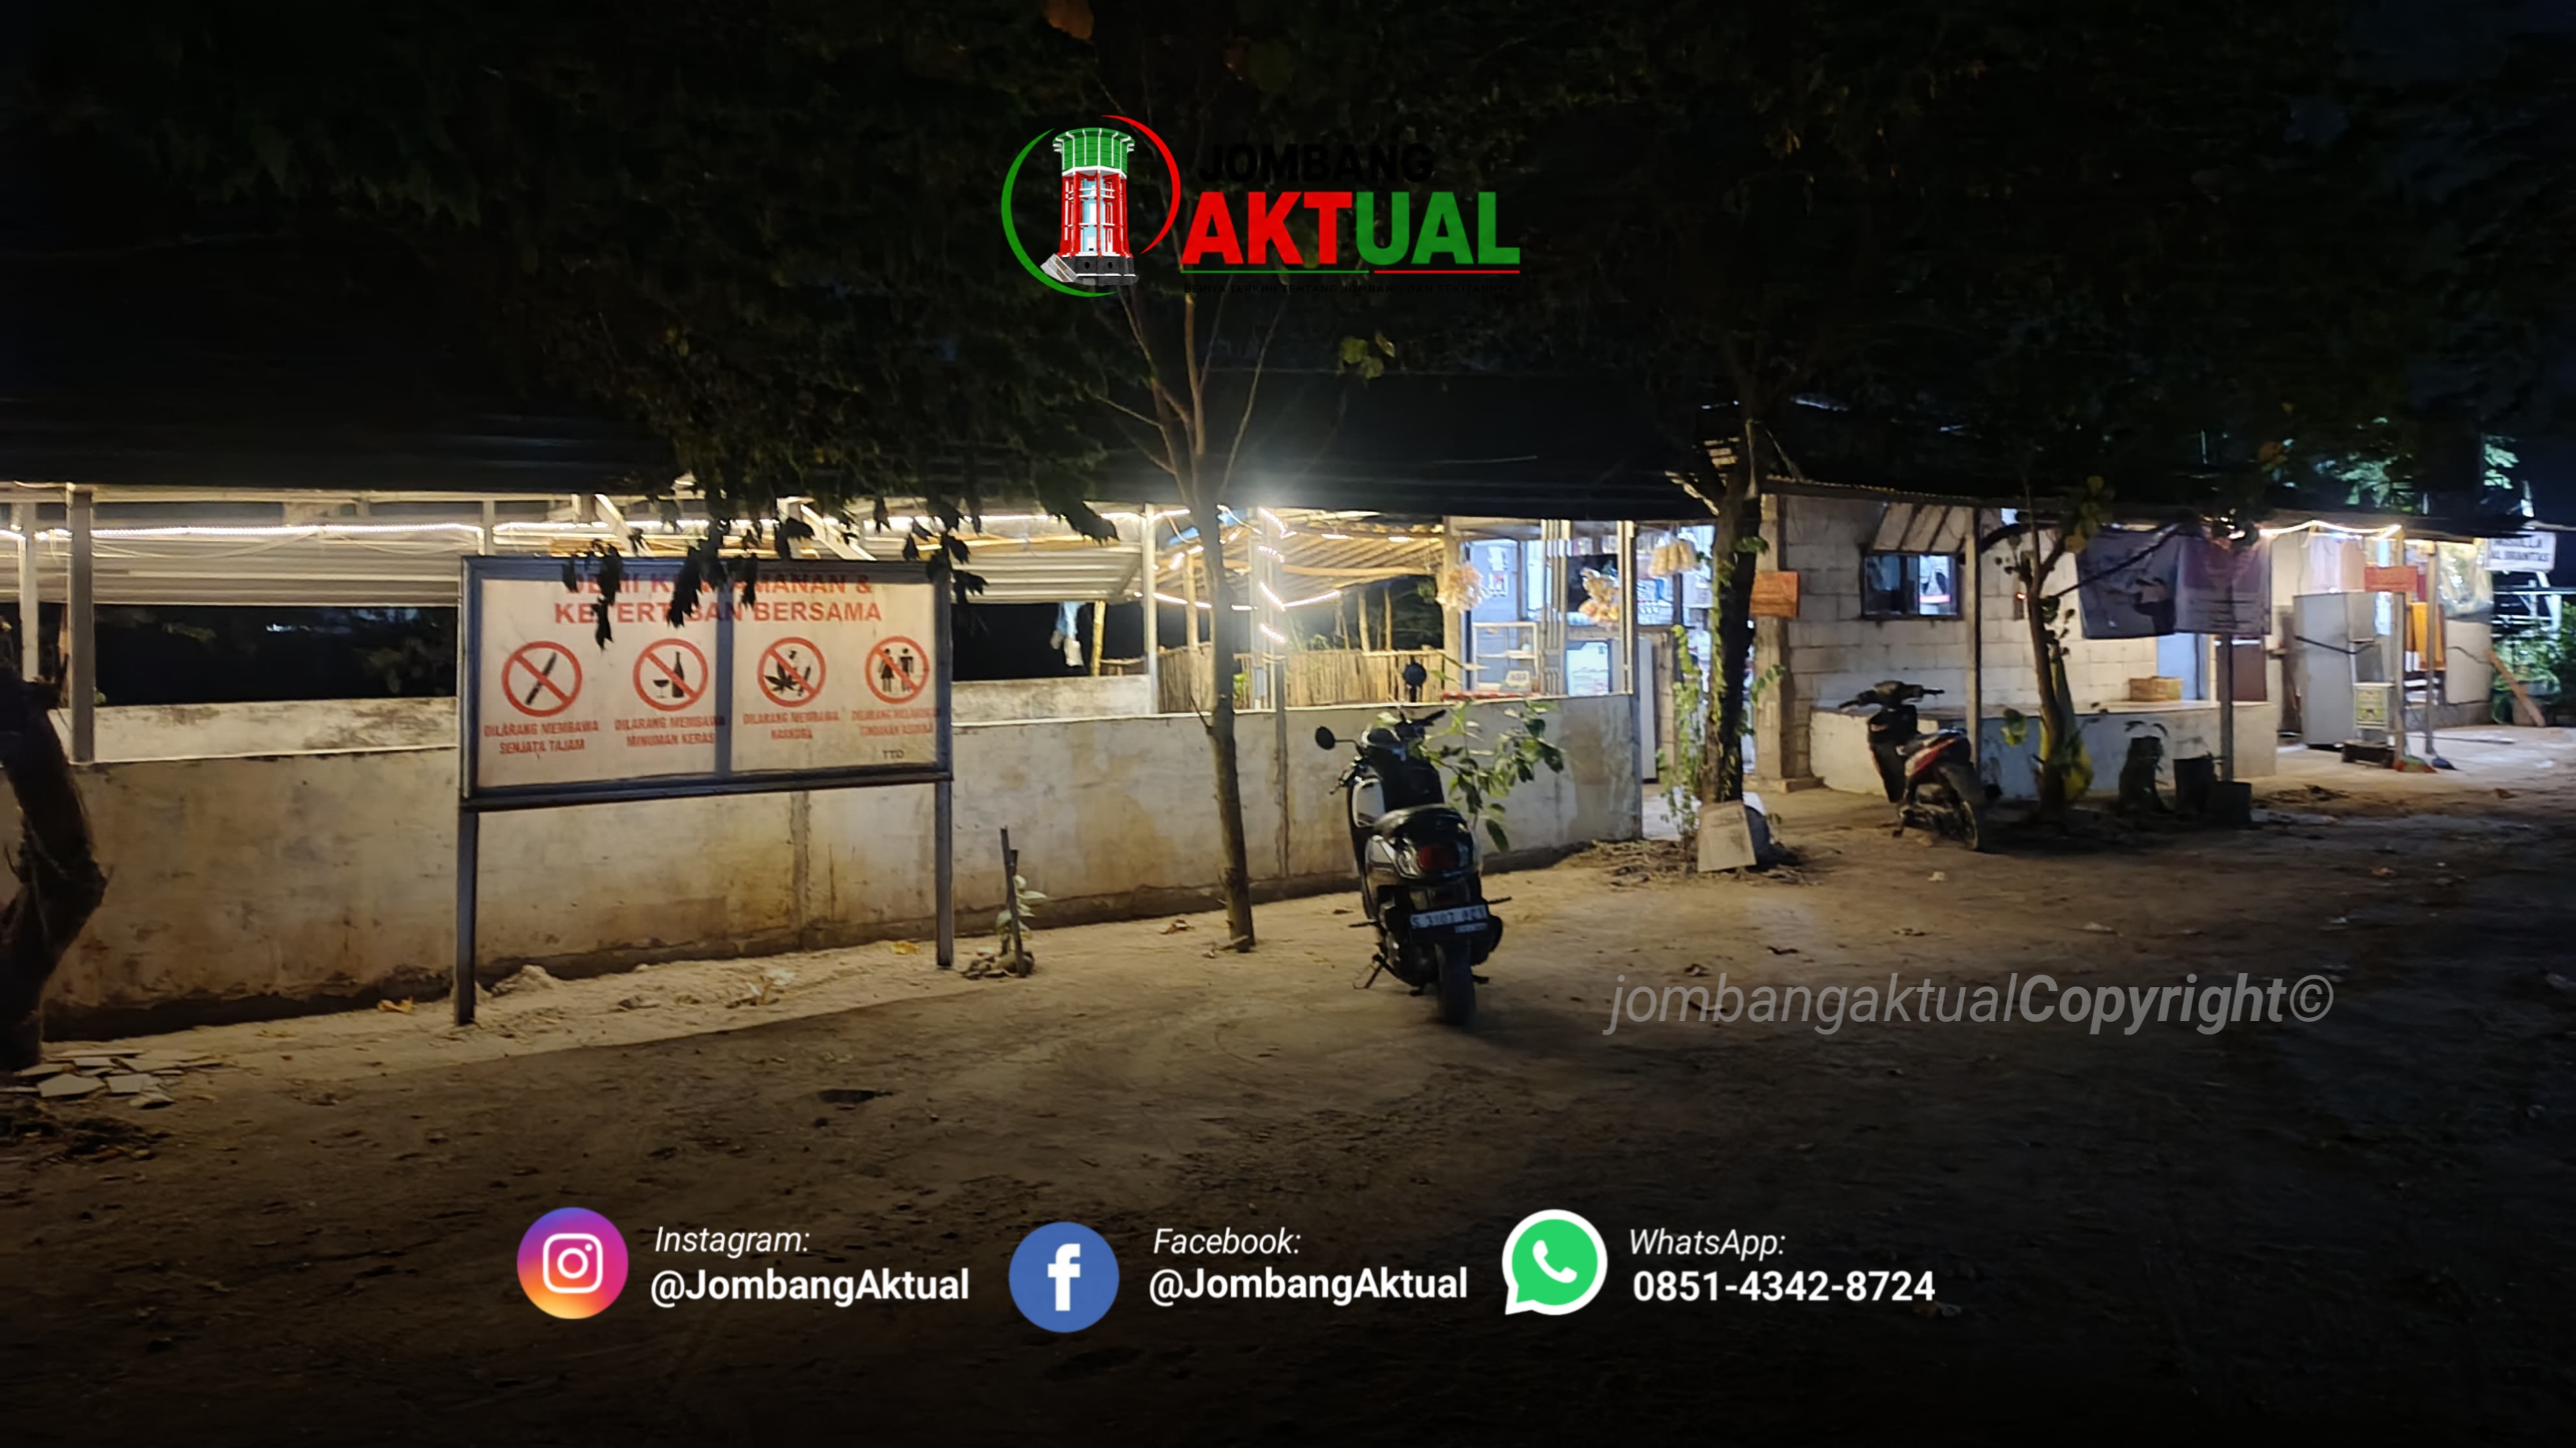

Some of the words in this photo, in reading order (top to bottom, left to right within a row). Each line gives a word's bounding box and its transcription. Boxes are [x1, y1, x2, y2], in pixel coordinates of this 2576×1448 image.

[566, 573, 639, 593] DEI
[856, 574, 872, 594] &
[555, 601, 743, 623] KEERTBAN
[754, 601, 882, 622] BERSAMA
[614, 717, 666, 731] DILARANG
[743, 713, 788, 724] DILARANG
[483, 723, 538, 737] DILARANG
[541, 720, 599, 734] MEMBAWA
[500, 740, 546, 754] SENJATA
[549, 739, 586, 752] TAJAM
[627, 733, 678, 747] MINUMAN
[682, 732, 715, 745] KERAS
